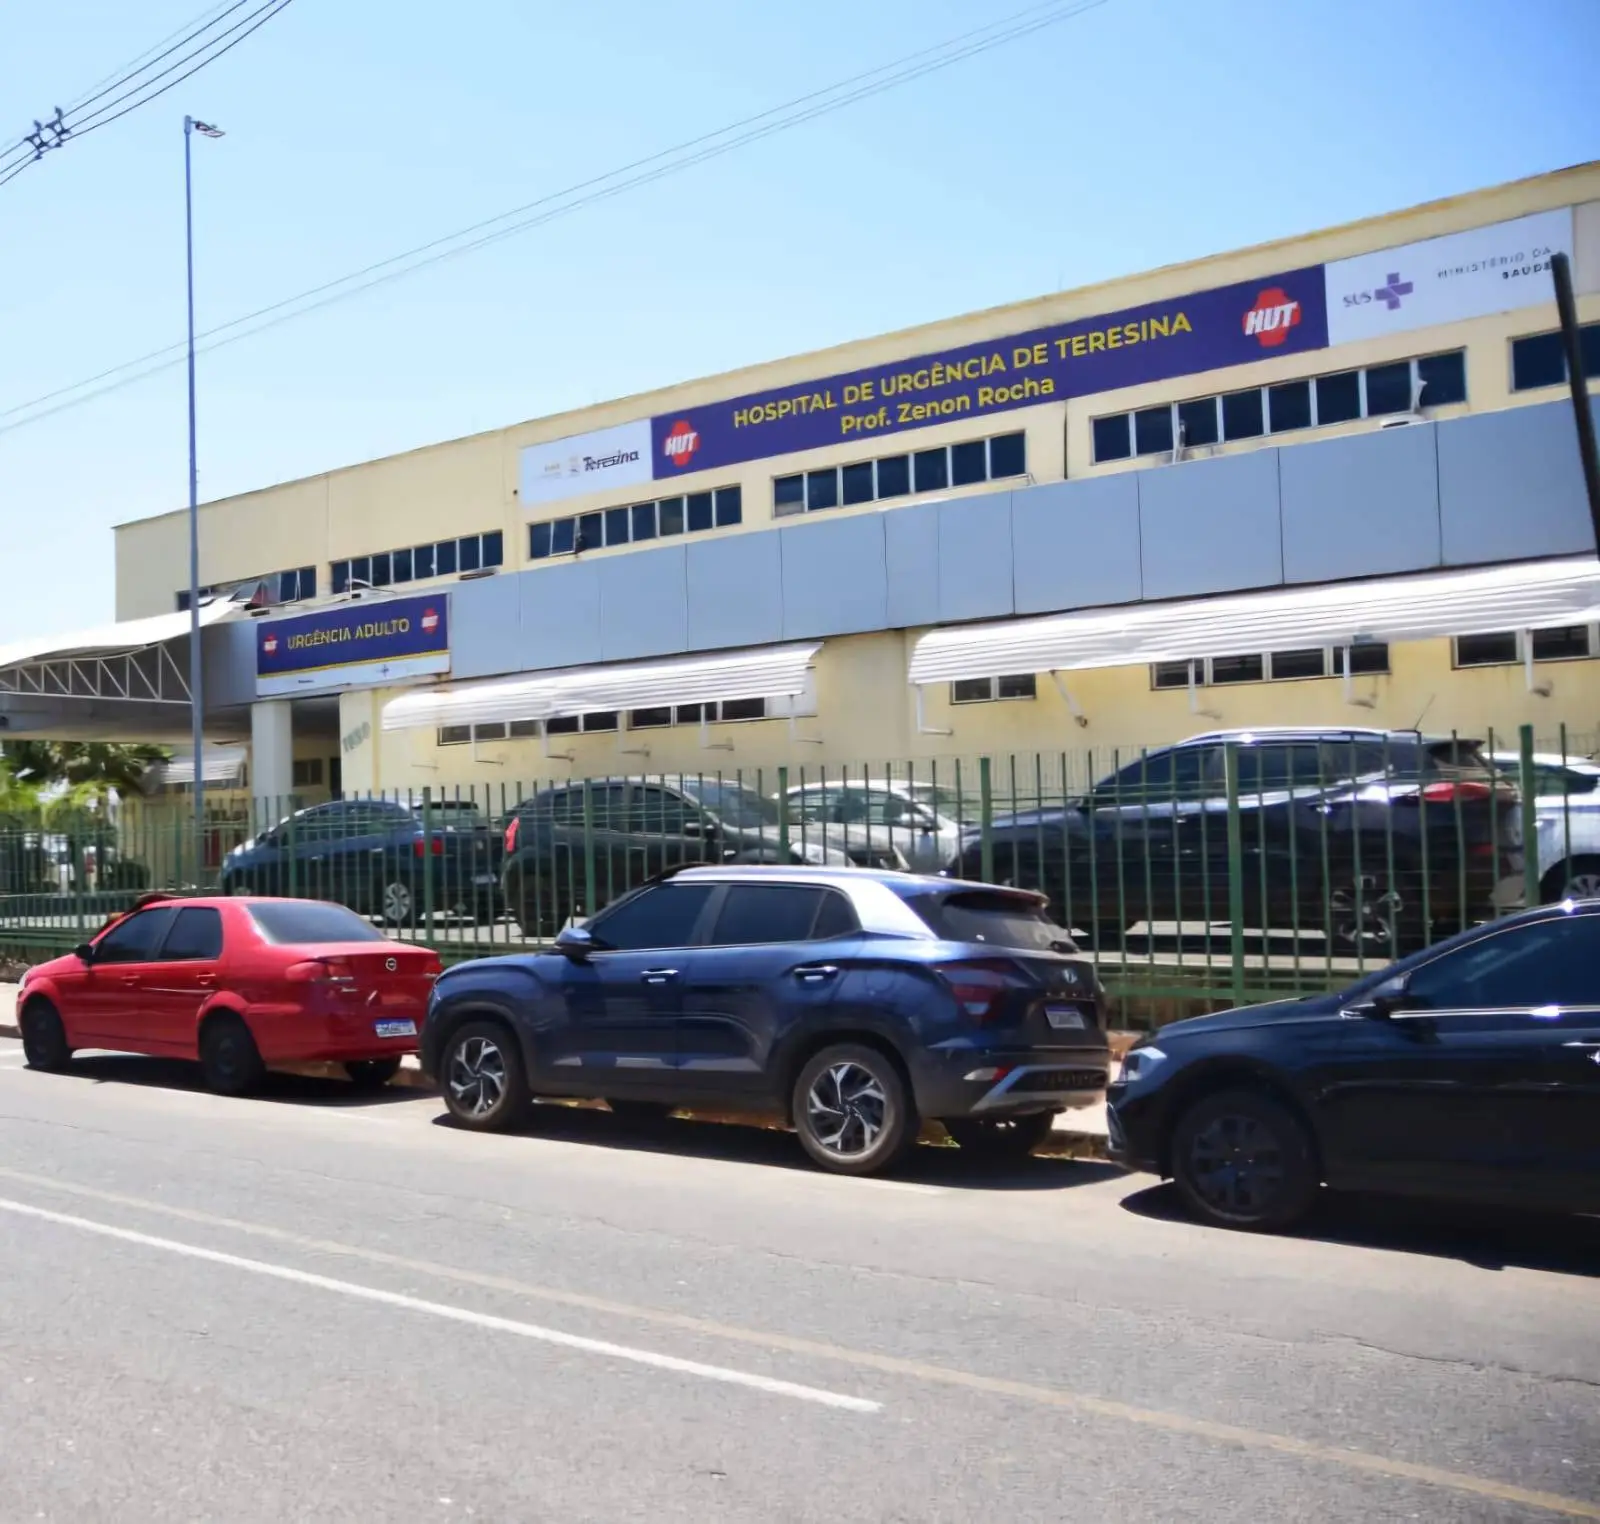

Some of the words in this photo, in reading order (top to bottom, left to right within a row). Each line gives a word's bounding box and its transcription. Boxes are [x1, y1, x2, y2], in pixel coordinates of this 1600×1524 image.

[1245, 302, 1298, 335] HUT
[733, 390, 837, 428] HOSPITAL
[843, 382, 875, 405] DE
[881, 353, 1006, 396] URGÊNCIA
[1013, 343, 1049, 369] DE
[1055, 312, 1192, 359] TERESINA
[841, 405, 892, 434] Prof.
[897, 394, 970, 423] Zenon
[978, 377, 1055, 407] Rocha
[665, 432, 698, 456] HUT
[583, 449, 640, 471] Teresina
[355, 618, 410, 639] ADULTO
